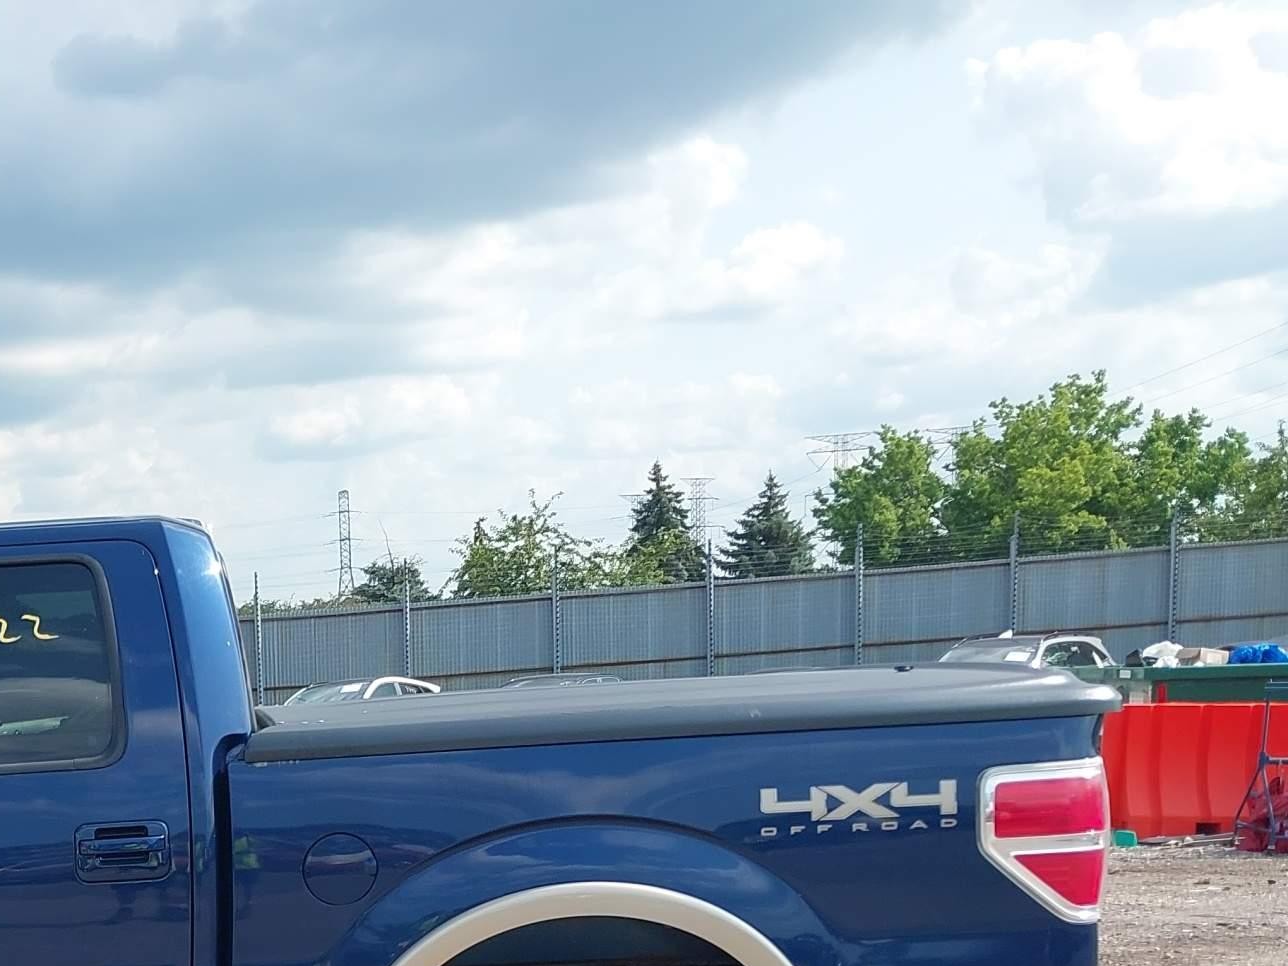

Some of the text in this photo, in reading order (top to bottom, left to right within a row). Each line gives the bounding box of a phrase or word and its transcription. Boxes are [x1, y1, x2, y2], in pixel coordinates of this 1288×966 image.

[760, 779, 958, 822] 4X4
[760, 818, 958, 837] OFF ROAD
